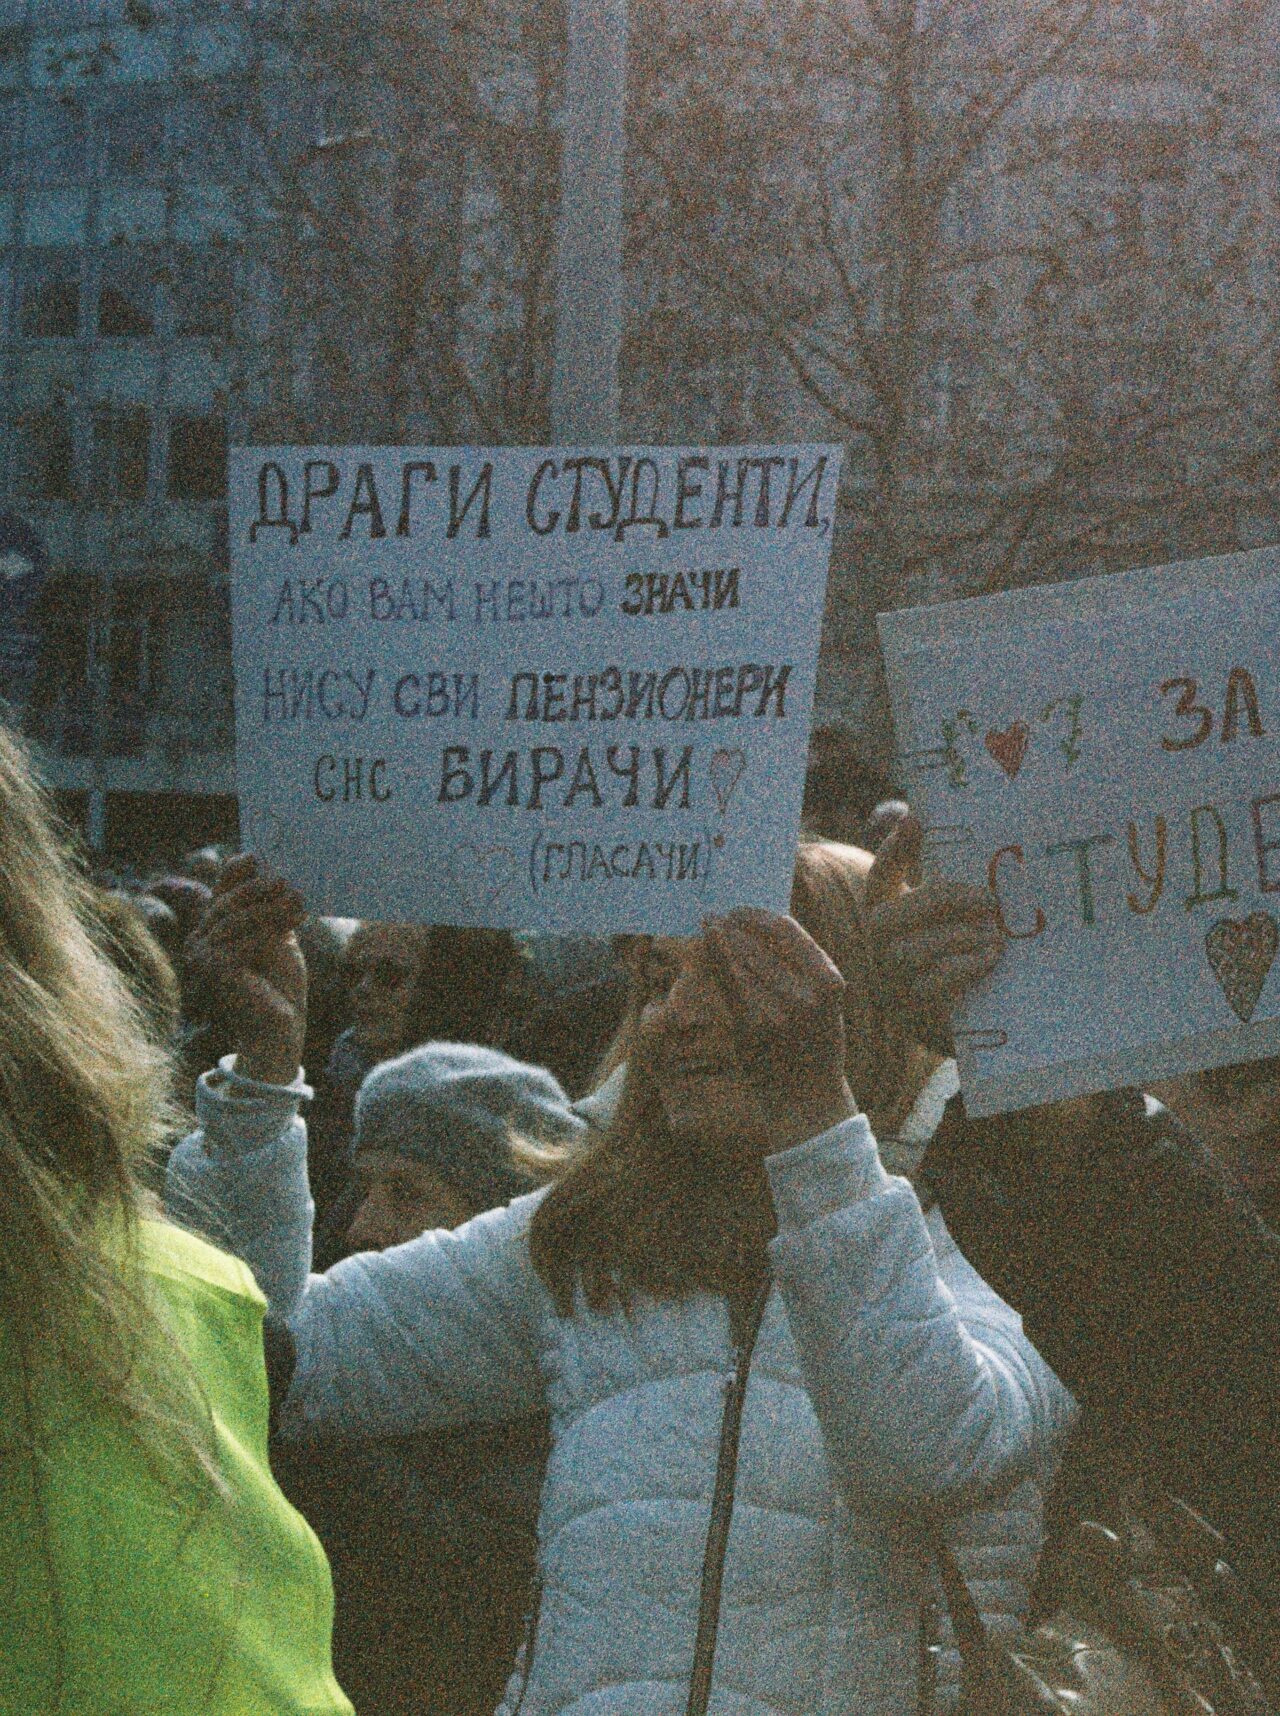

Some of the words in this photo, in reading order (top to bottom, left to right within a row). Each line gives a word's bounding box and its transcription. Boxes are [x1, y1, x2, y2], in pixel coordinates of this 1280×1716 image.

[250, 460, 494, 544] ДРАГИ
[526, 456, 831, 541] СТУДЕНТИ,
[271, 580, 347, 624] АКО
[368, 578, 458, 623] ВАМ
[473, 577, 605, 623] НЕШТО
[620, 568, 742, 616] ЗНАЧИ
[263, 668, 376, 722] НИСУ
[394, 674, 482, 720] СВИ
[507, 663, 793, 722] ПЕНЗИОНЕРИ
[1160, 666, 1266, 752] ЗА
[314, 754, 393, 802] СНС
[438, 746, 692, 811] БИРАЧИ
